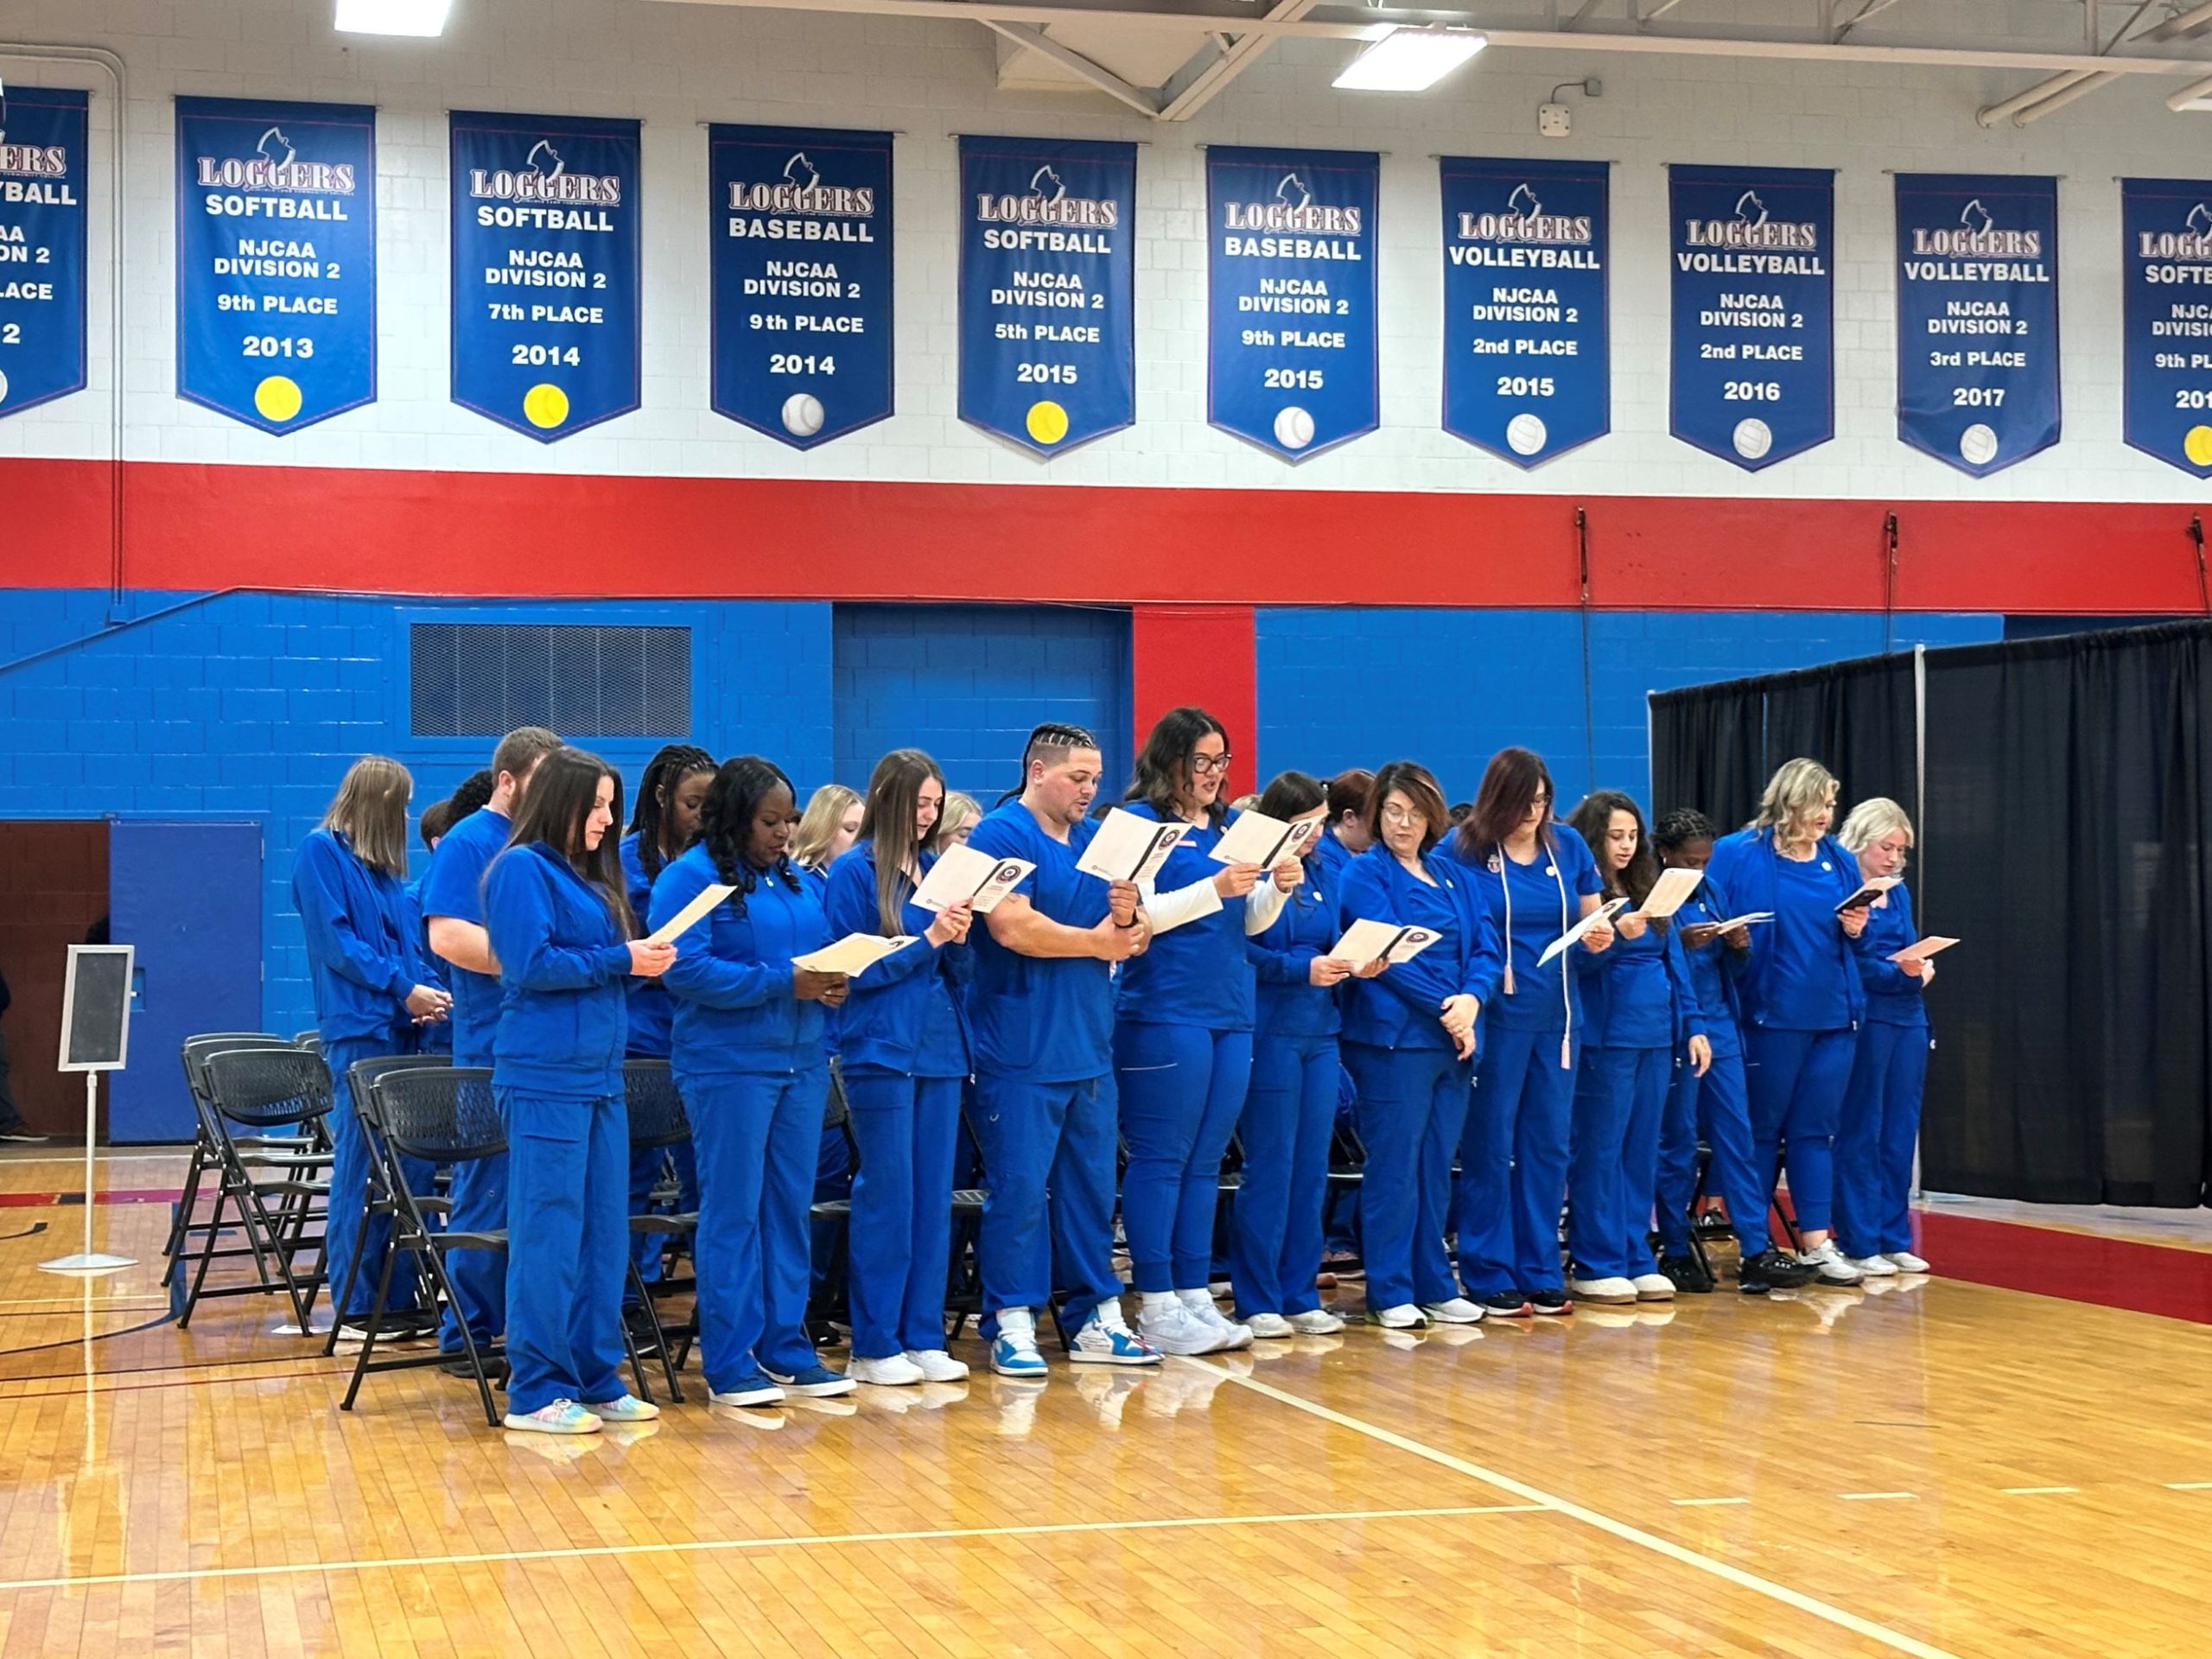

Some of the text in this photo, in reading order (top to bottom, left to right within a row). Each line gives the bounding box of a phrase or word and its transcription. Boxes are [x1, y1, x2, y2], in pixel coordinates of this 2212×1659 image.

[196, 156, 356, 194] LOGGERS
[467, 167, 622, 205] LOGGERS
[206, 194, 348, 221] SOFTBALL
[728, 180, 876, 216] LOGGERS
[477, 205, 613, 232] SOFTBALL
[976, 193, 1119, 228] LOGGERS
[1224, 200, 1363, 235] LOGGERS
[729, 217, 874, 243] BASEBALL
[1457, 211, 1592, 245] LOGGERS
[1684, 218, 1817, 250] LOGGERS
[238, 238, 316, 259] NJCAA
[984, 229, 1112, 254] SOFTBALL
[1224, 236, 1362, 260] BASEBALL
[1911, 226, 2042, 259] LOGGERS
[35, 247, 50, 264] 2
[509, 249, 583, 269] NJCAA
[1448, 245, 1600, 270] VOLLEYBALL
[1677, 252, 1826, 276] VOLLEYBALL
[214, 257, 340, 279] DIVISION 2
[485, 267, 607, 289] DIVISION 2
[766, 260, 838, 279] NJCAA
[1904, 262, 2050, 283] VOLLEYBALL
[744, 278, 861, 299] DIVISION 2
[1014, 270, 1083, 290] NJCAA
[1260, 278, 1328, 296] NJCAA
[0, 282, 53, 300] ACE
[991, 289, 1104, 309] DIVISION 2
[1492, 287, 1559, 304] NJCAA
[1720, 293, 1784, 310] NJCAA
[217, 294, 338, 315] 9th PLACE
[488, 303, 604, 324] 7th PLACE
[1238, 296, 1349, 315] DIVISION 2
[1472, 305, 1579, 323] DIVISION 2
[1947, 301, 2010, 317] NJCAA
[2171, 303, 2212, 320] NJC
[749, 314, 864, 334] 9th PLACE
[1700, 310, 1803, 328] DIVISION 2
[1928, 319, 2028, 335] DIVISION 2
[2152, 321, 2212, 337] DIVISI
[995, 323, 1100, 343] 5th PLACE
[1242, 329, 1345, 348] 9th PLACE
[243, 335, 314, 359] 2013
[512, 344, 581, 366] 2014
[1473, 338, 1578, 356] 2nd PLACE
[1700, 343, 1803, 361] 2nd PLACE
[770, 353, 836, 375] 2014
[1929, 351, 2026, 367] 3rd PLACE
[2155, 353, 2186, 368] 9th
[1017, 363, 1077, 385] 2015
[1264, 368, 1324, 390] 2015
[1497, 376, 1555, 397] 2015
[1724, 381, 1781, 401] 2016
[1953, 387, 2005, 407] 2017
